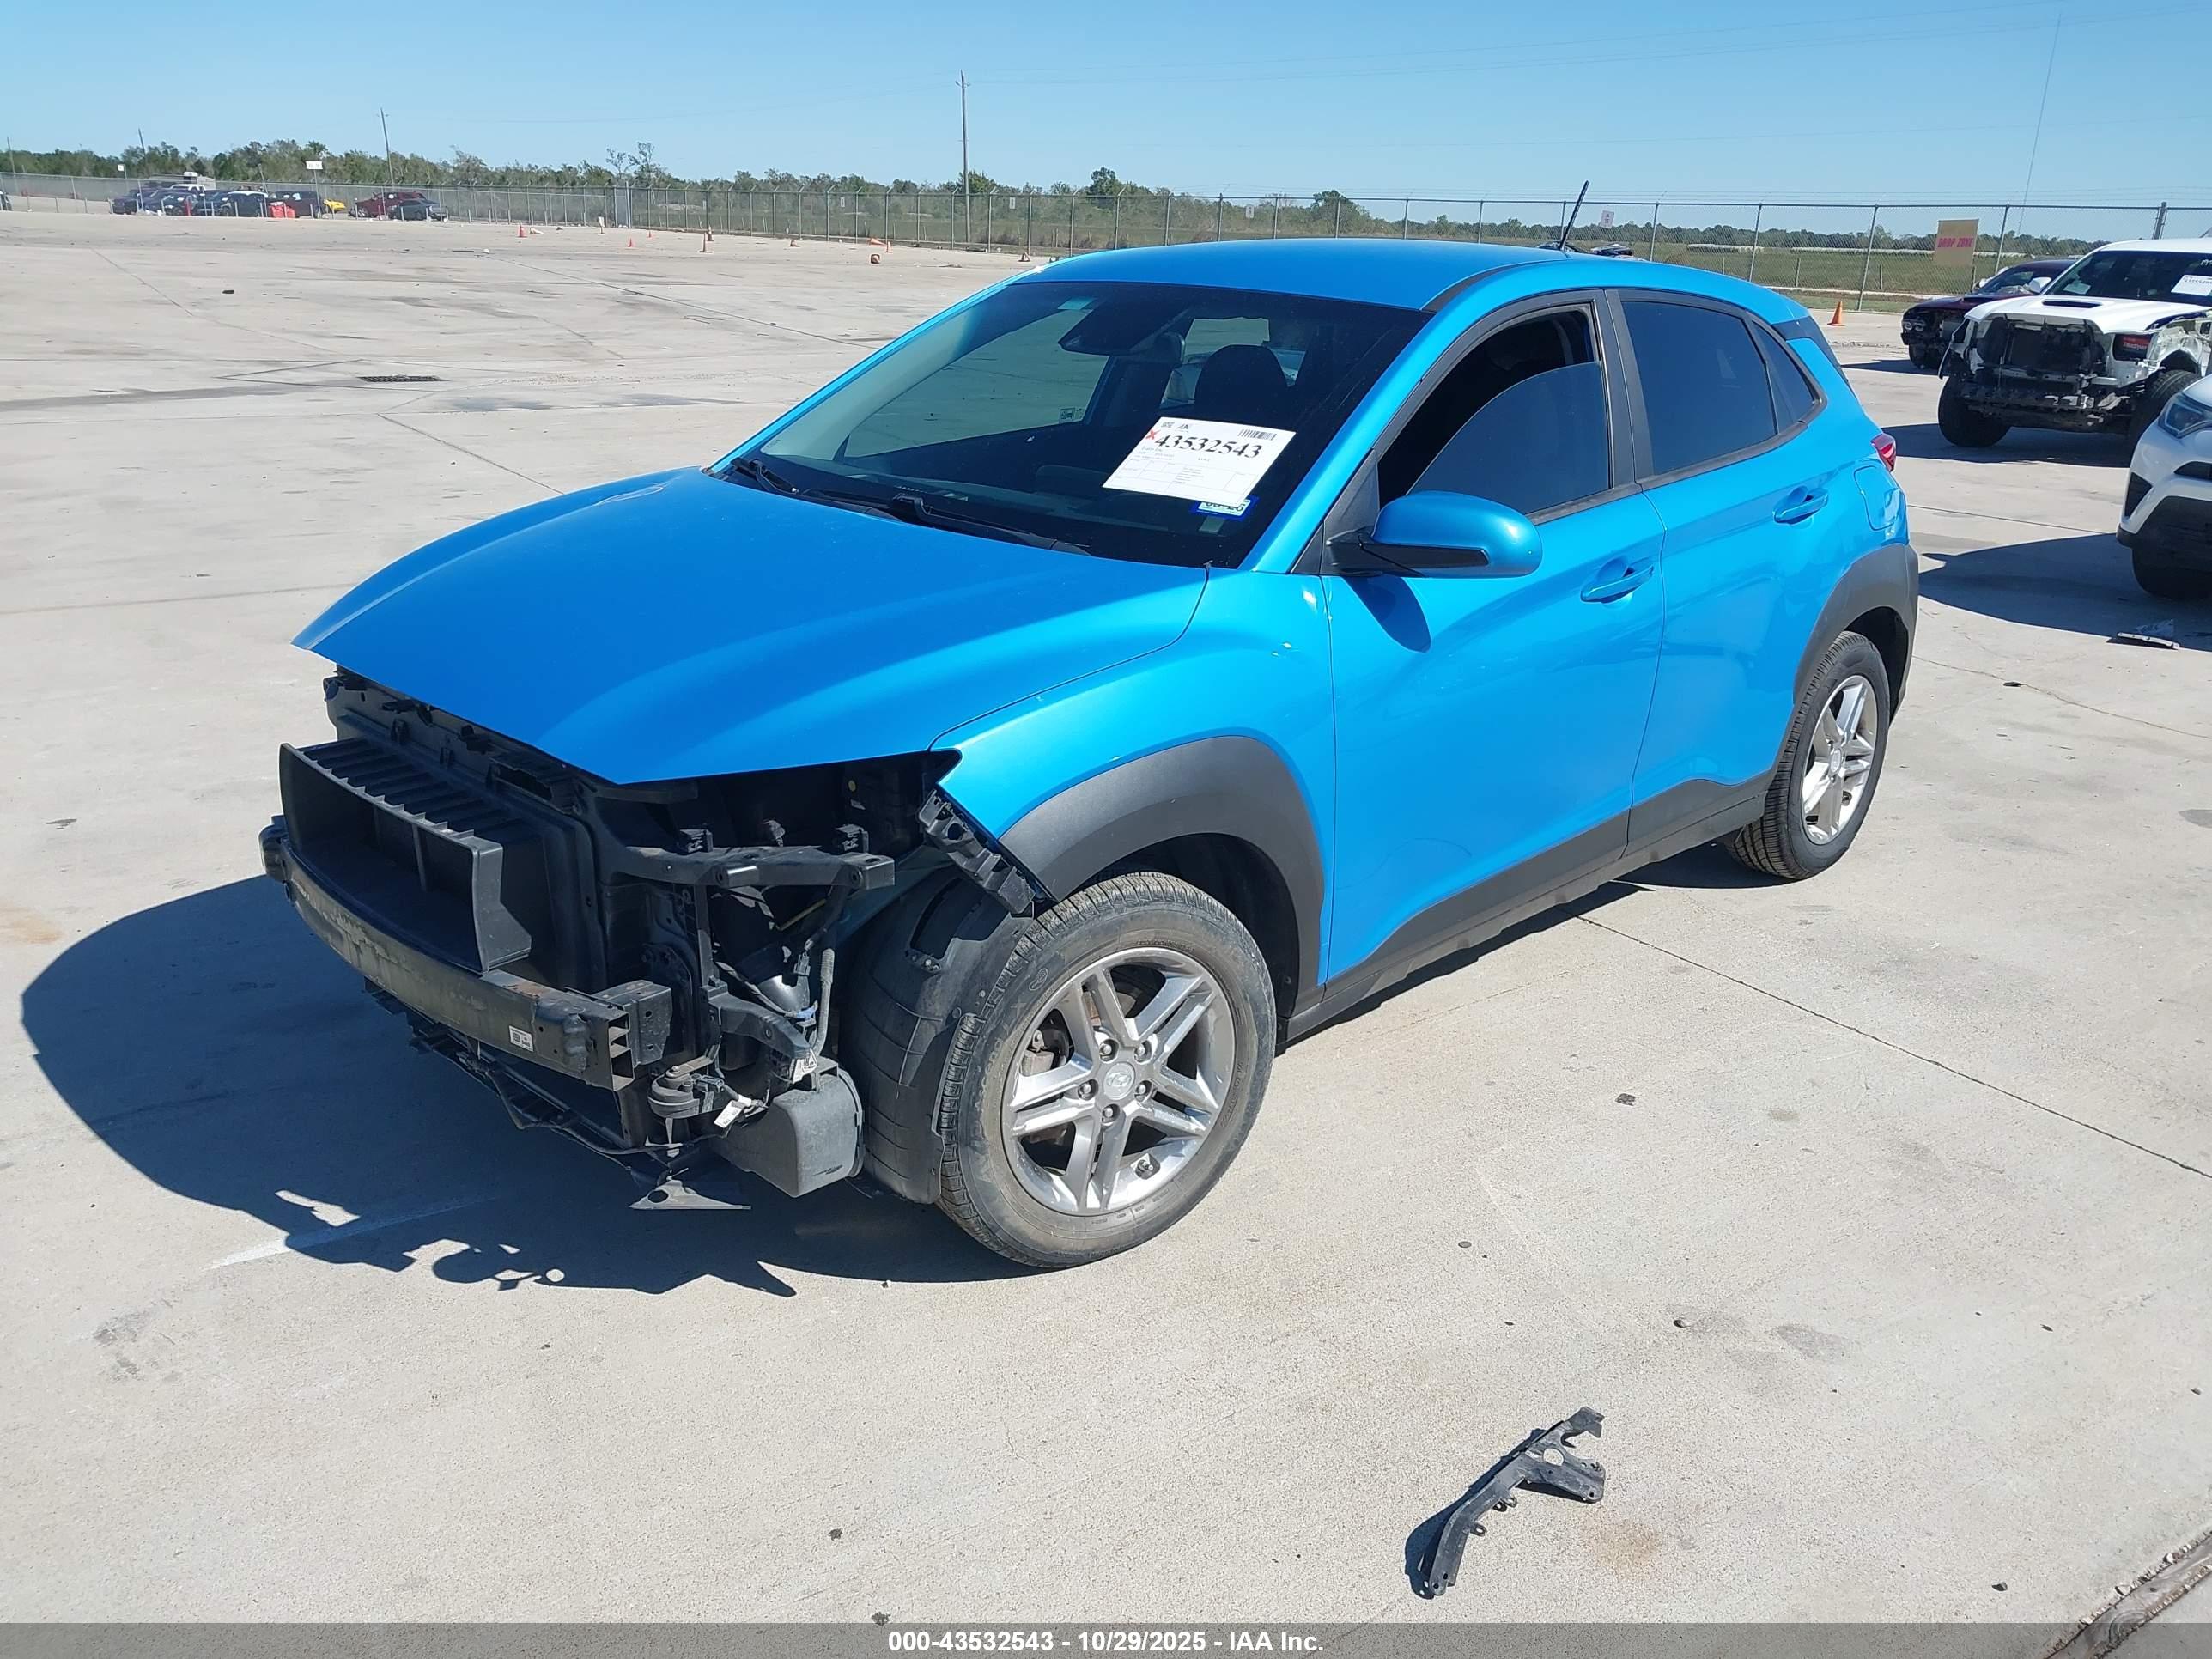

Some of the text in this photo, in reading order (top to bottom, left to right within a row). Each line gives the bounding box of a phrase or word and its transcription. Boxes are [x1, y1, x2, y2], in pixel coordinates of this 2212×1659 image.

[1938, 237, 1974, 248] DROP ZONE
[1155, 433, 1263, 459] 43532543
